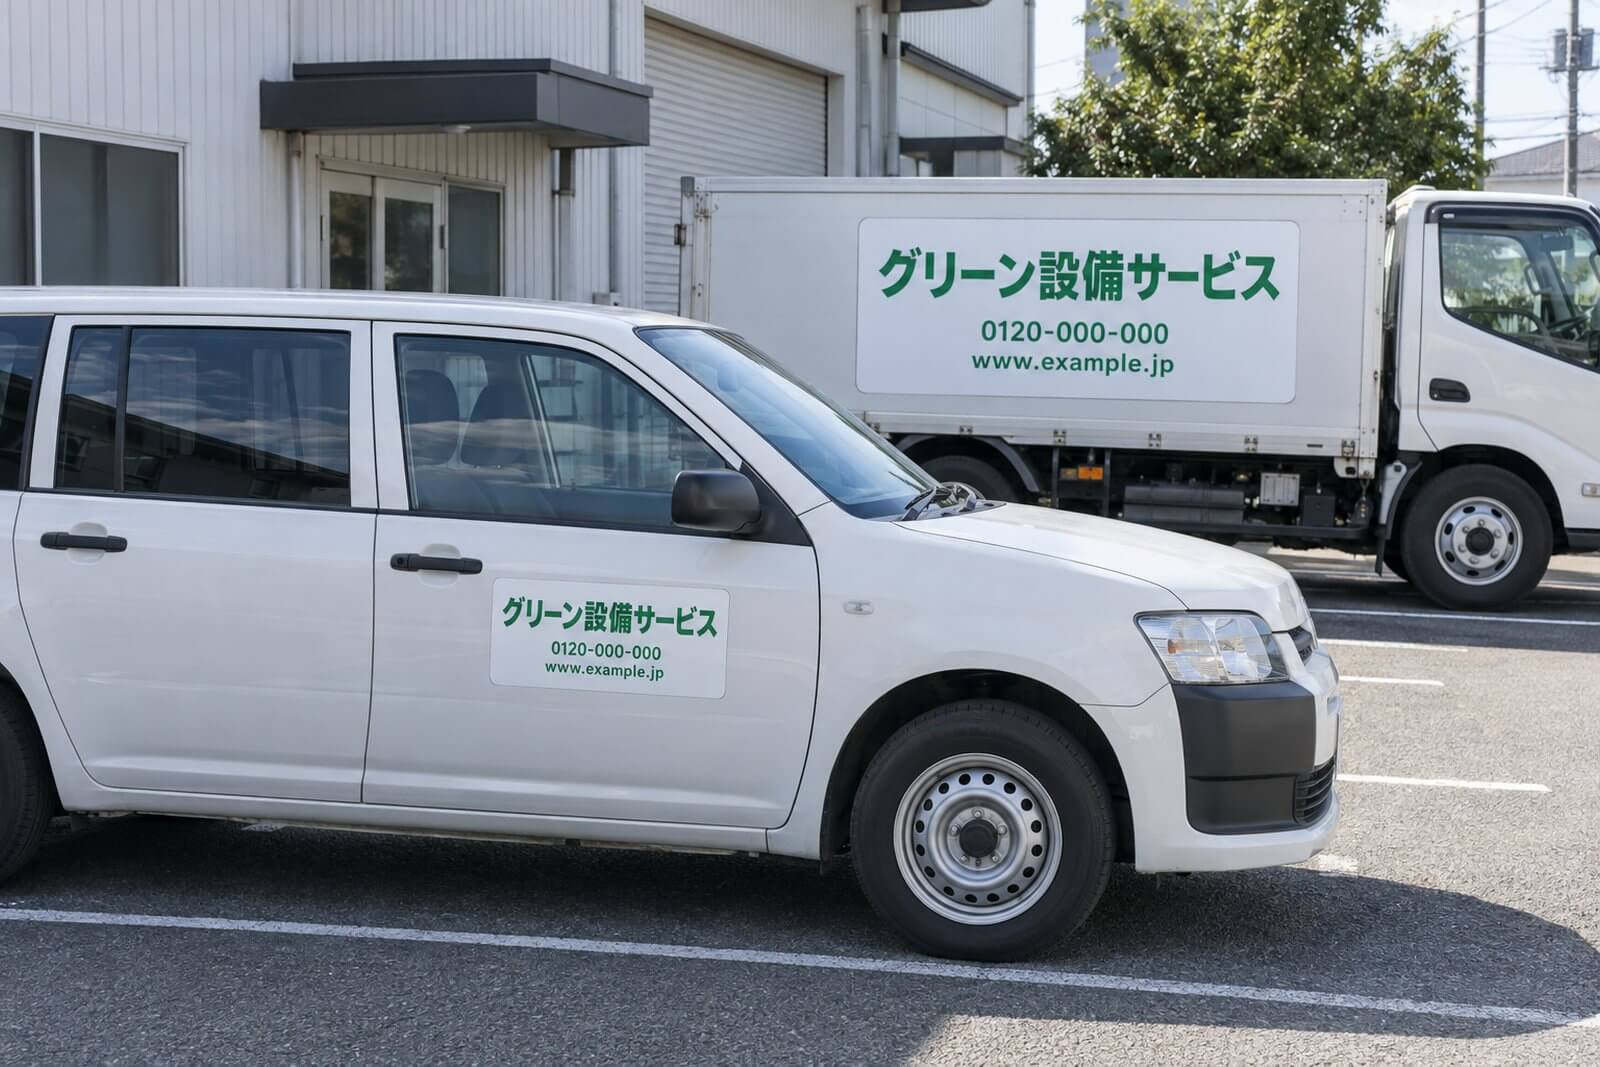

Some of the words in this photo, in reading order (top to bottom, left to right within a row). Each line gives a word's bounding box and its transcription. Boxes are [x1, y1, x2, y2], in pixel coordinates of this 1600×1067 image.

[879, 247, 1280, 301] グリーン設備サービス
[980, 319, 1169, 345] 0120-000-000
[971, 351, 1174, 377] www.example.jp
[502, 596, 717, 637] グリーン設備サービス
[551, 641, 661, 660] 0120-000-000
[545, 662, 664, 681] www.example.jp
